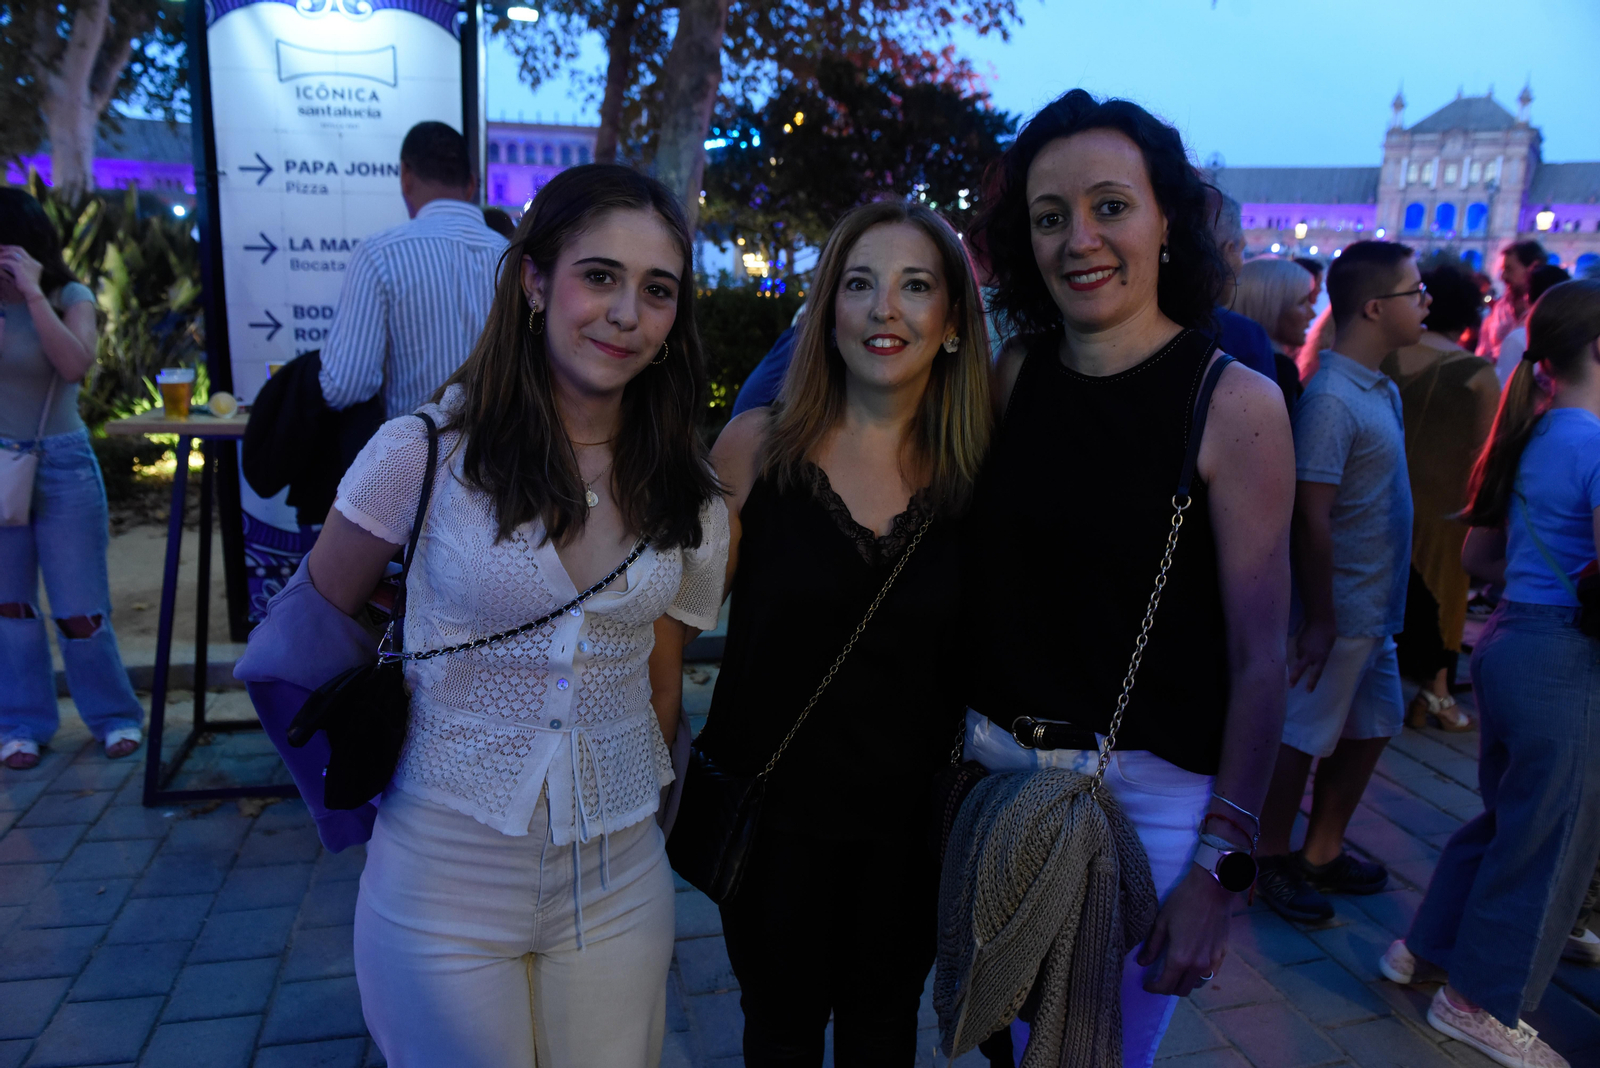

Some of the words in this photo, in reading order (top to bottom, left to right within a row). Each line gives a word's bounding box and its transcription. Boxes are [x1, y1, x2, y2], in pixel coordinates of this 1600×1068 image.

[285, 159, 338, 176] PAPA
[286, 181, 329, 195] Pizza
[288, 237, 314, 252] LA
